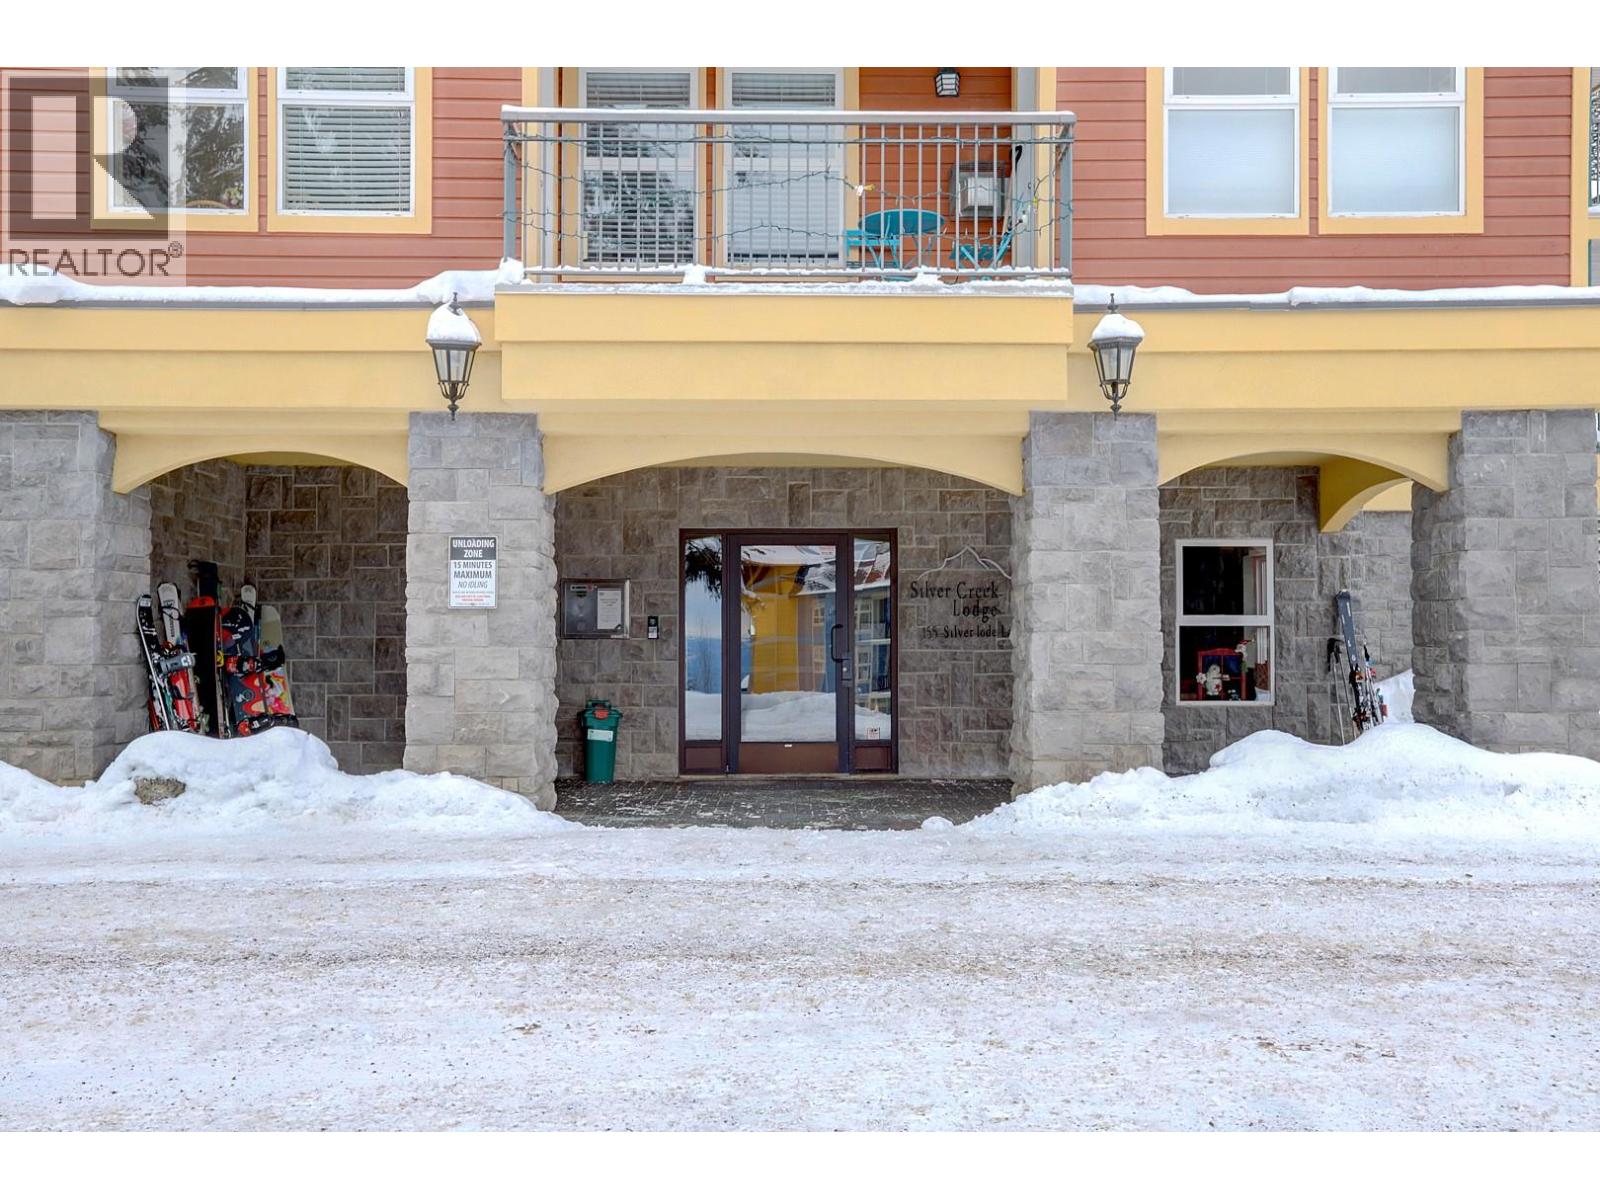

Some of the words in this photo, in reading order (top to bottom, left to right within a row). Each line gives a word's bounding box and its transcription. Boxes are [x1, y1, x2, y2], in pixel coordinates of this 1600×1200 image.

[452, 538, 495, 548] UNLOADING
[463, 549, 483, 558] ZONE
[453, 561, 462, 569] 15
[463, 561, 493, 569] MINUTES
[454, 570, 492, 579] MAXIMUM
[457, 581, 468, 589] NO
[468, 581, 488, 589] IDLING
[910, 581, 951, 598] Silver
[956, 581, 999, 600] Creek
[953, 600, 999, 624] Lodge
